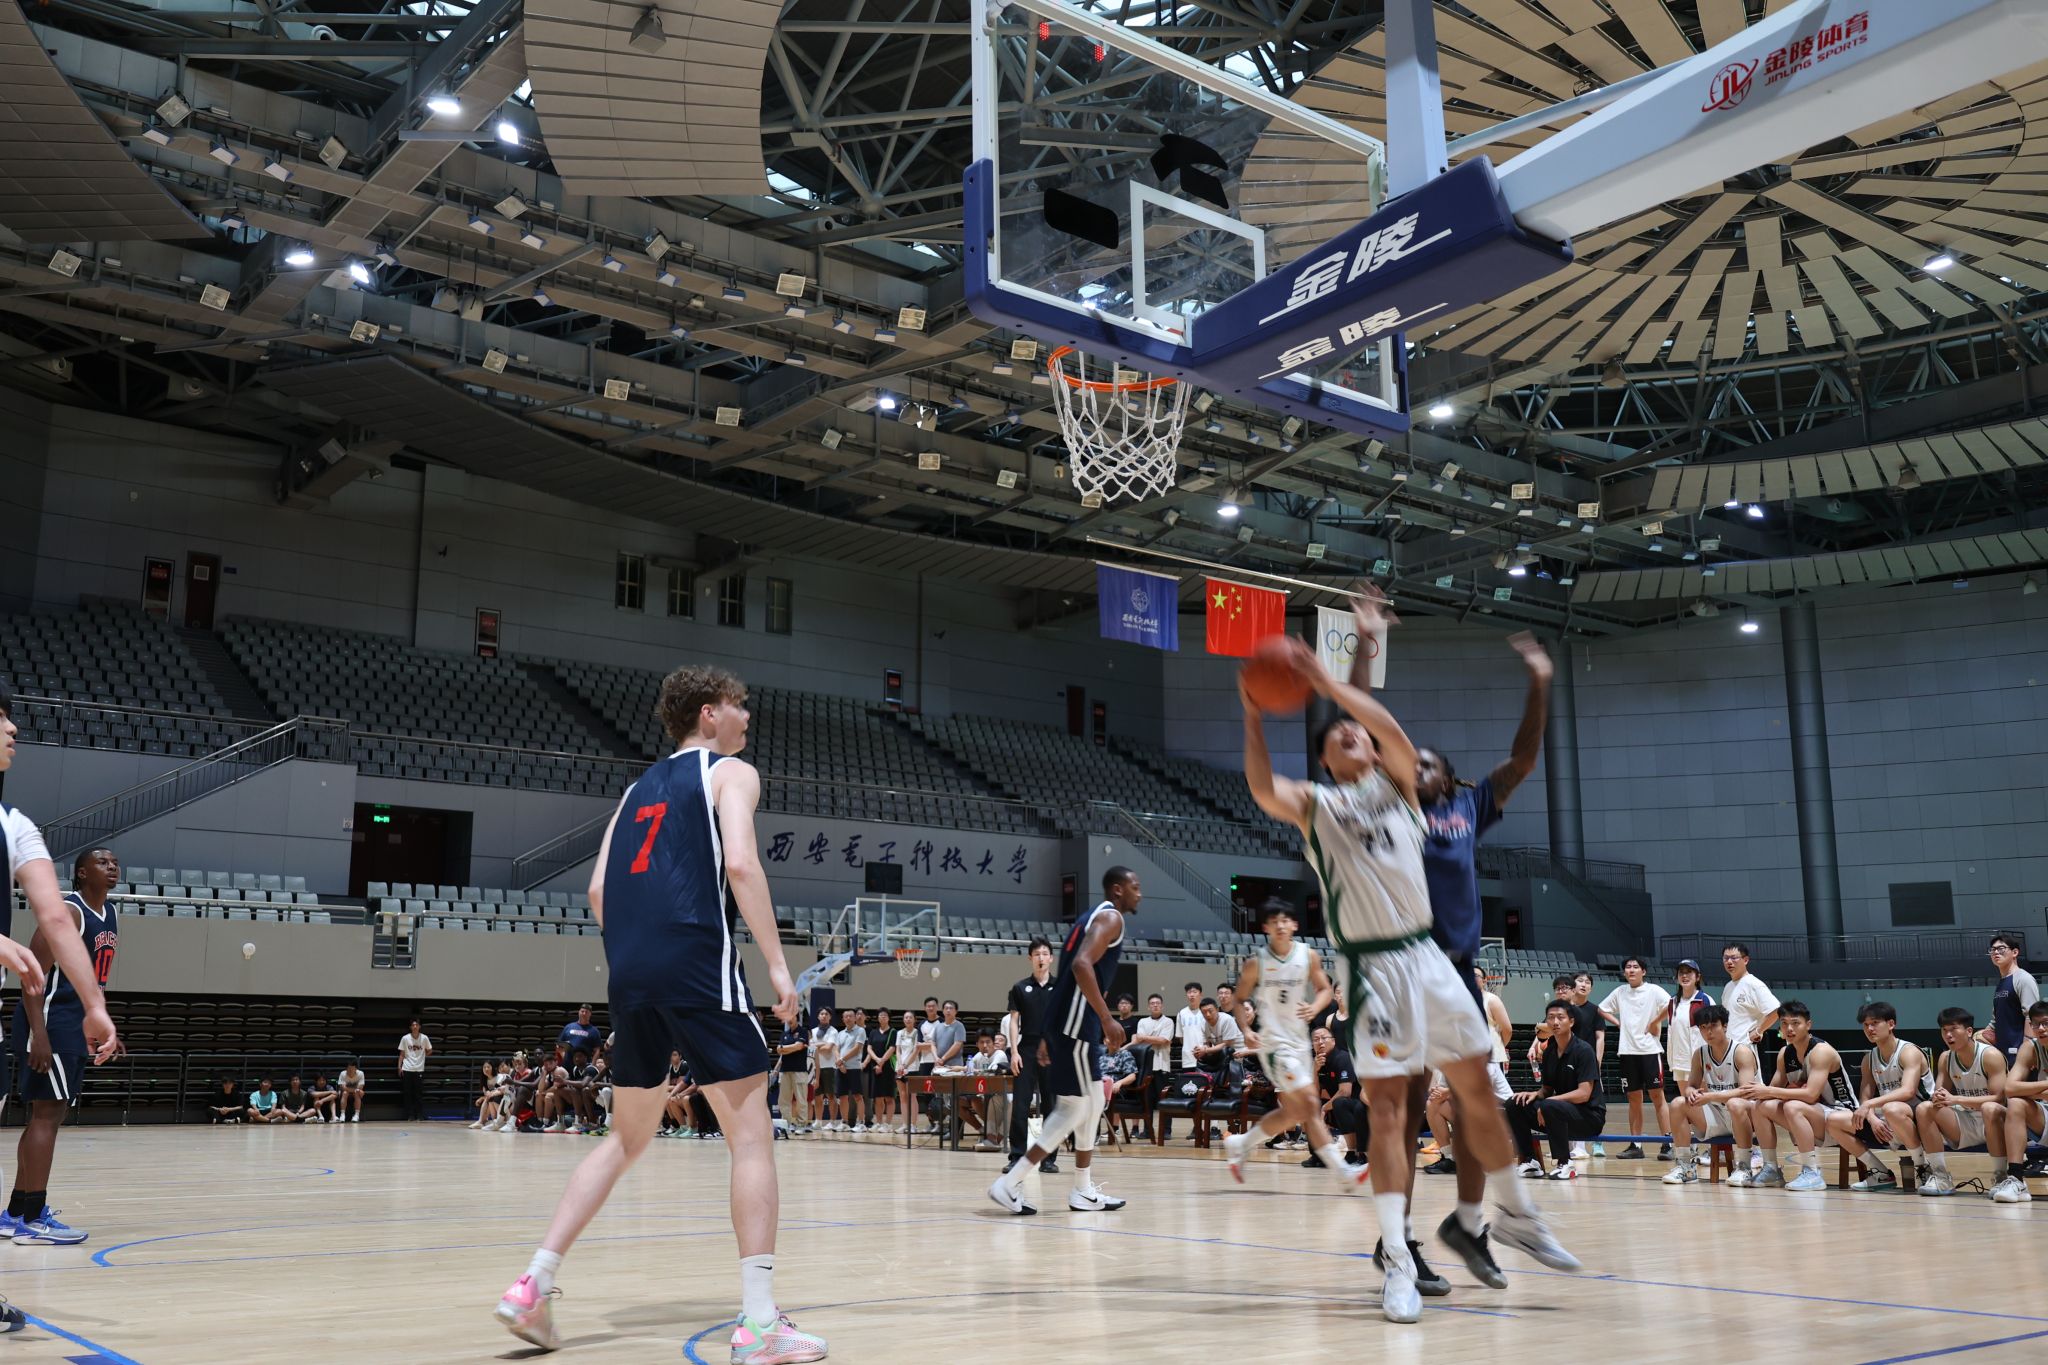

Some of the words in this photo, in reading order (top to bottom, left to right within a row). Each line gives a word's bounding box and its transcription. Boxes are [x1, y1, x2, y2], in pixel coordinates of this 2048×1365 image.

[1763, 10, 1869, 76] 金陵体育
[1764, 60, 1812, 87] JINLING
[1816, 34, 1868, 63] SPORTS
[1280, 211, 1430, 310] 金陵
[630, 802, 668, 874] 7
